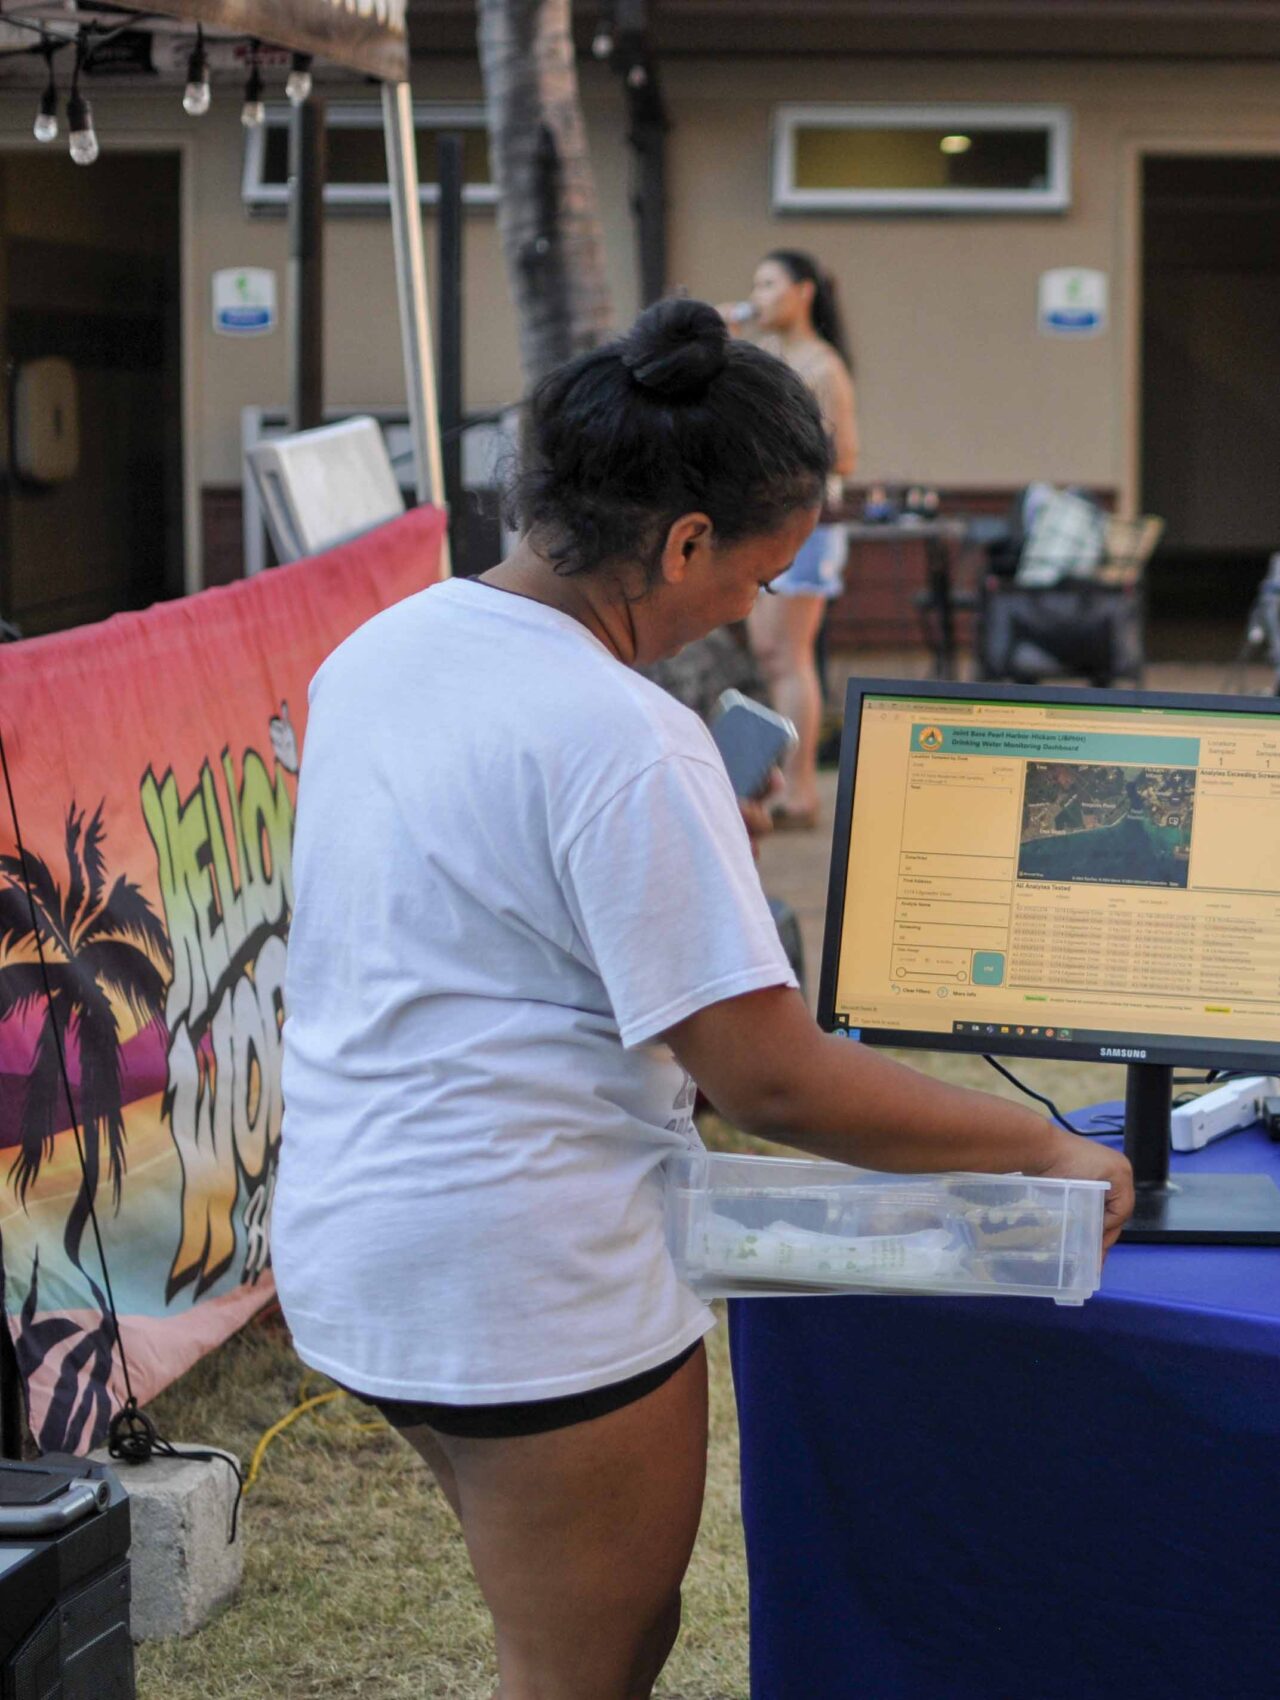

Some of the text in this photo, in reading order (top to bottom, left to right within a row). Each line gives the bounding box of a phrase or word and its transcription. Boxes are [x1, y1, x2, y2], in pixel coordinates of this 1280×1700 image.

[952, 738, 1079, 751] Drinking Water Monitoring Dashboard
[1227, 771, 1256, 779] Exceeding
[1100, 1047, 1147, 1059] SAMSUNG
